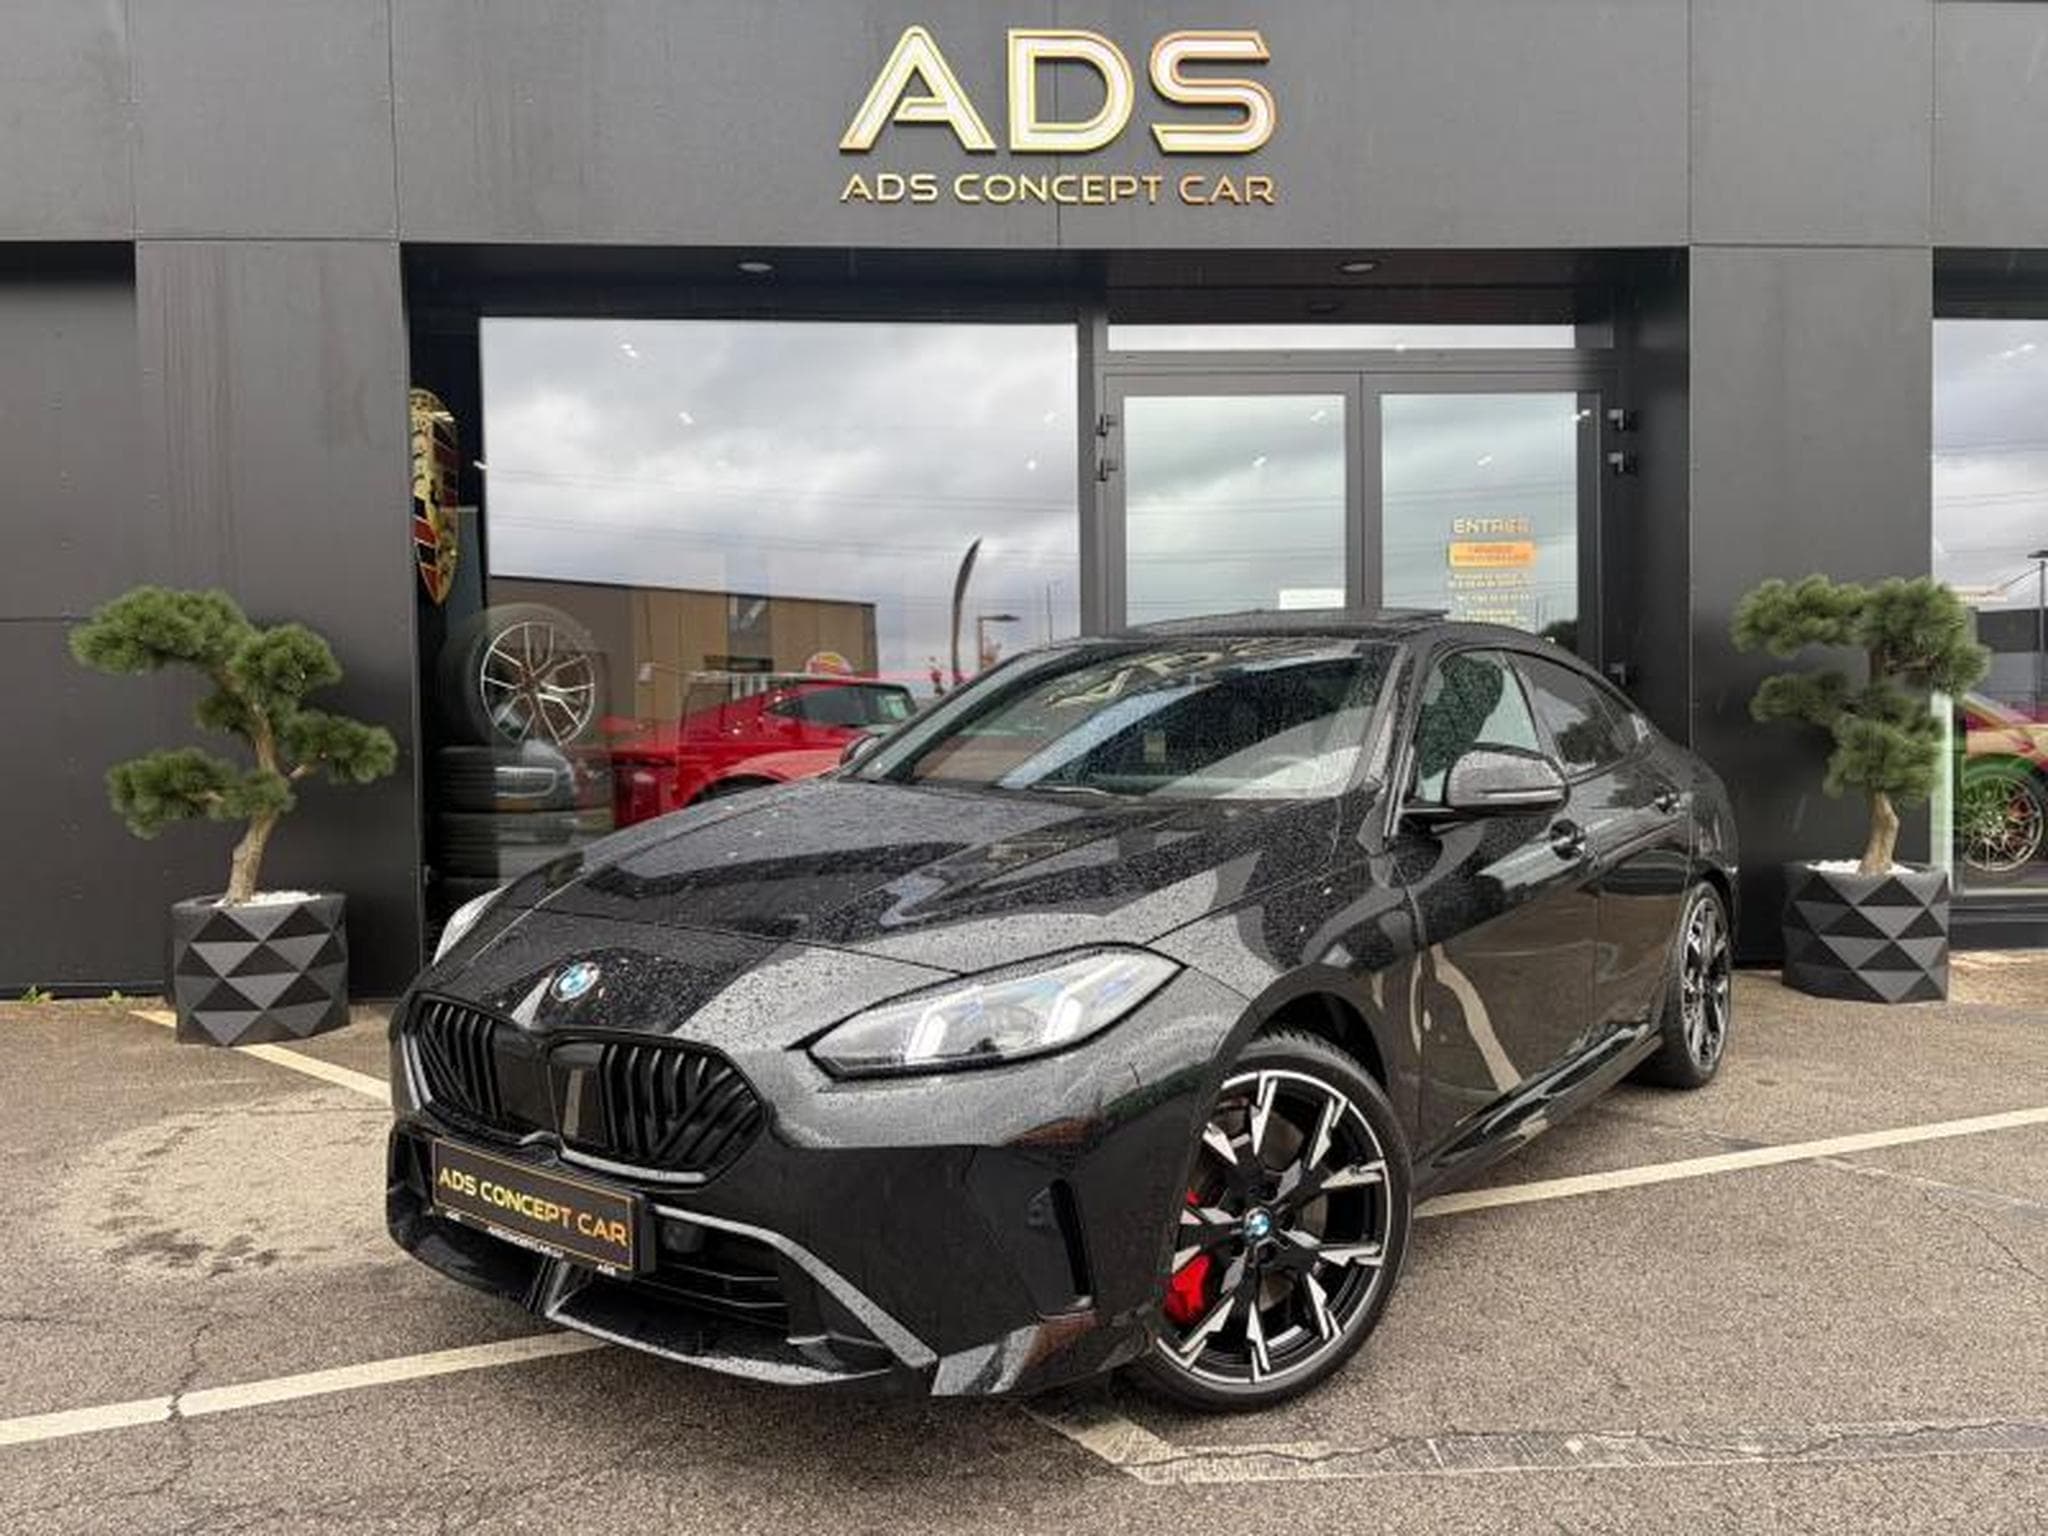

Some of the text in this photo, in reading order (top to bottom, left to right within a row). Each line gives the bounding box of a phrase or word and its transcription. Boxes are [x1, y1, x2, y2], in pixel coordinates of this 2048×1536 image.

[839, 24, 1277, 154] ADS
[839, 173, 1276, 205] ADS CONCEPT CAR
[439, 1167, 477, 1196] ADS
[480, 1181, 572, 1230] CONCEPT
[577, 1212, 627, 1246] CAR
